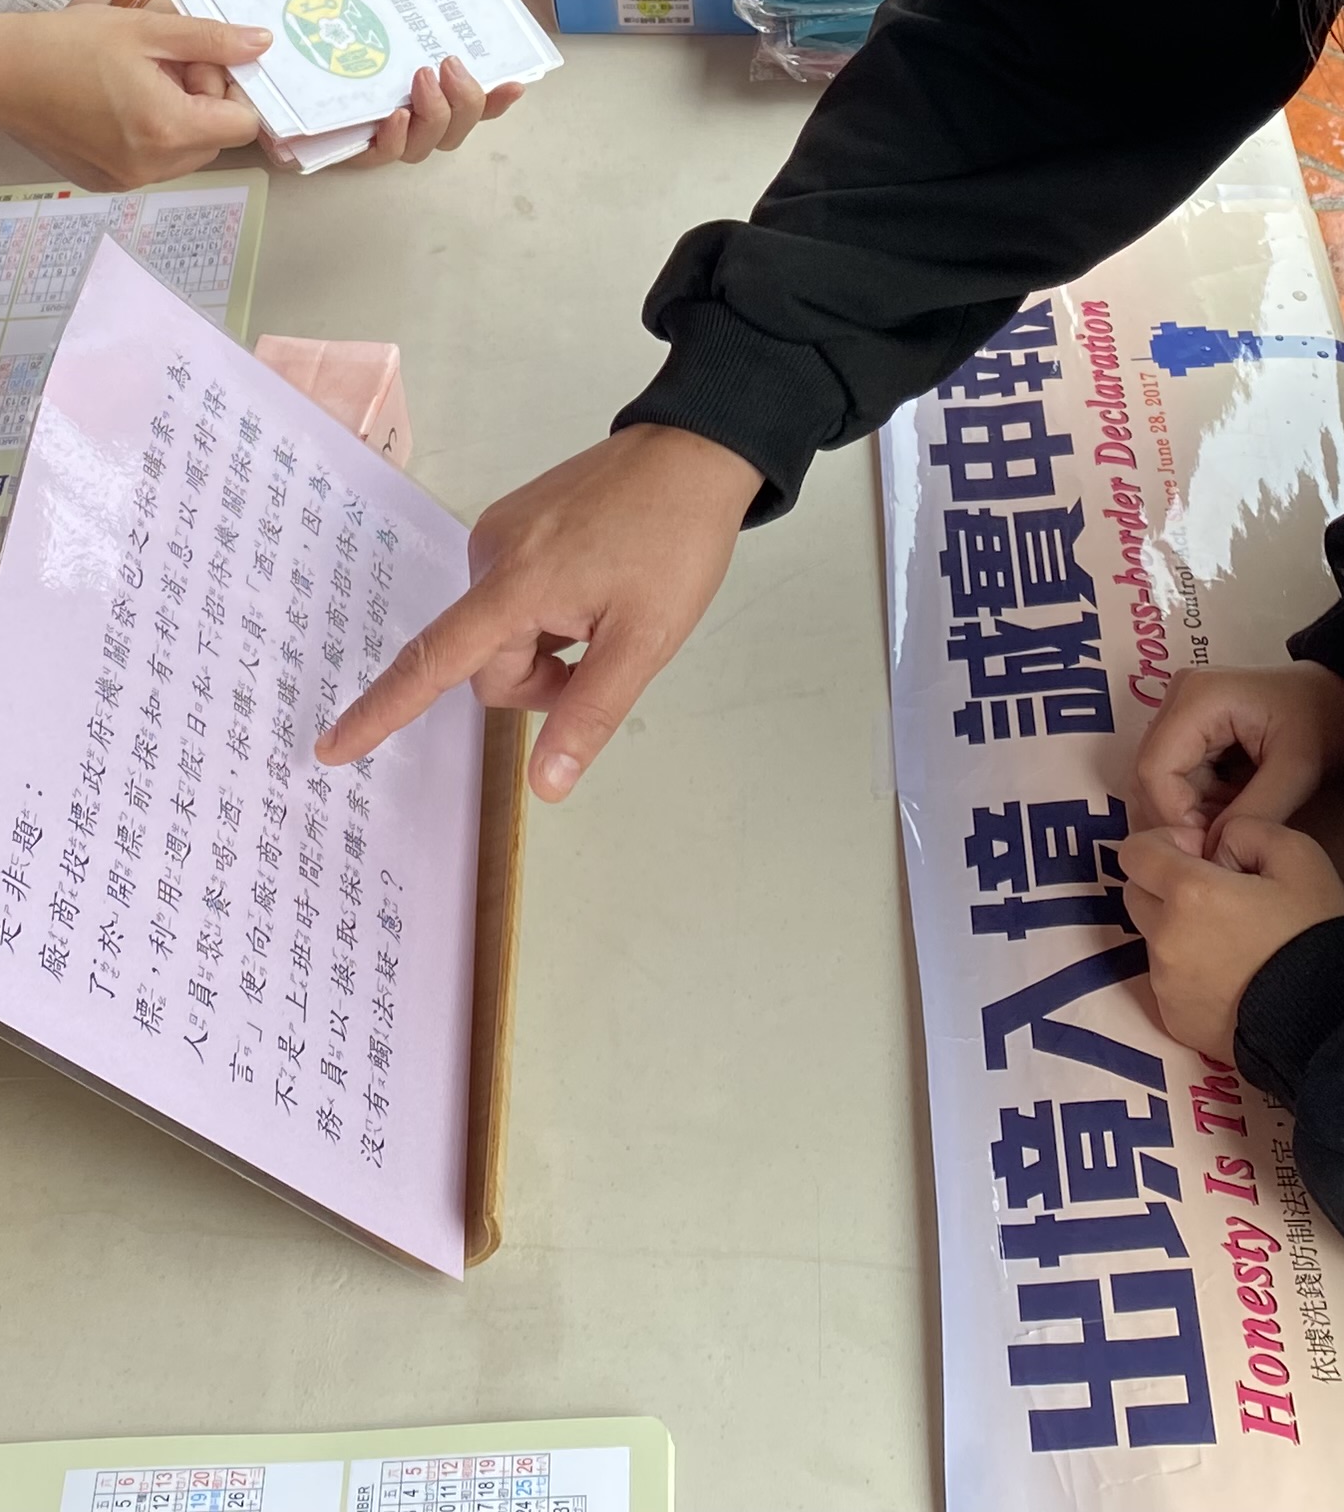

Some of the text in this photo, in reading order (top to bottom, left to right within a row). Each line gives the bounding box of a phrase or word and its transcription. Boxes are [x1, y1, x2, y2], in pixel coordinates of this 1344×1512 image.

[1139, 371, 1162, 408] 2017
[1147, 409, 1168, 436] 28,
[1157, 437, 1177, 476] June
[1076, 300, 1173, 709] Cross-border Declaration
[1176, 566, 1202, 630] Control
[1191, 635, 1209, 668] ing
[89, 377, 228, 999] 了於開標前探知有利消息以順利得
[275, 487, 368, 1116] 不是上班時間所為所以廠商招待公
[929, 298, 1218, 1453] 出境入境 誠實申報
[1203, 1154, 1260, 1206] Is
[1221, 1216, 1301, 1446] Honesty
[116, 1477, 135, 1508] 5 6
[153, 1473, 173, 1510] 12 13
[190, 1471, 210, 1508] 19 20
[227, 1471, 248, 1508] 26 27
[403, 1467, 422, 1497] 4 5
[441, 1462, 458, 1498] 11 12
[478, 1460, 496, 1497] 18 19
[516, 1458, 533, 1496] 25 26
